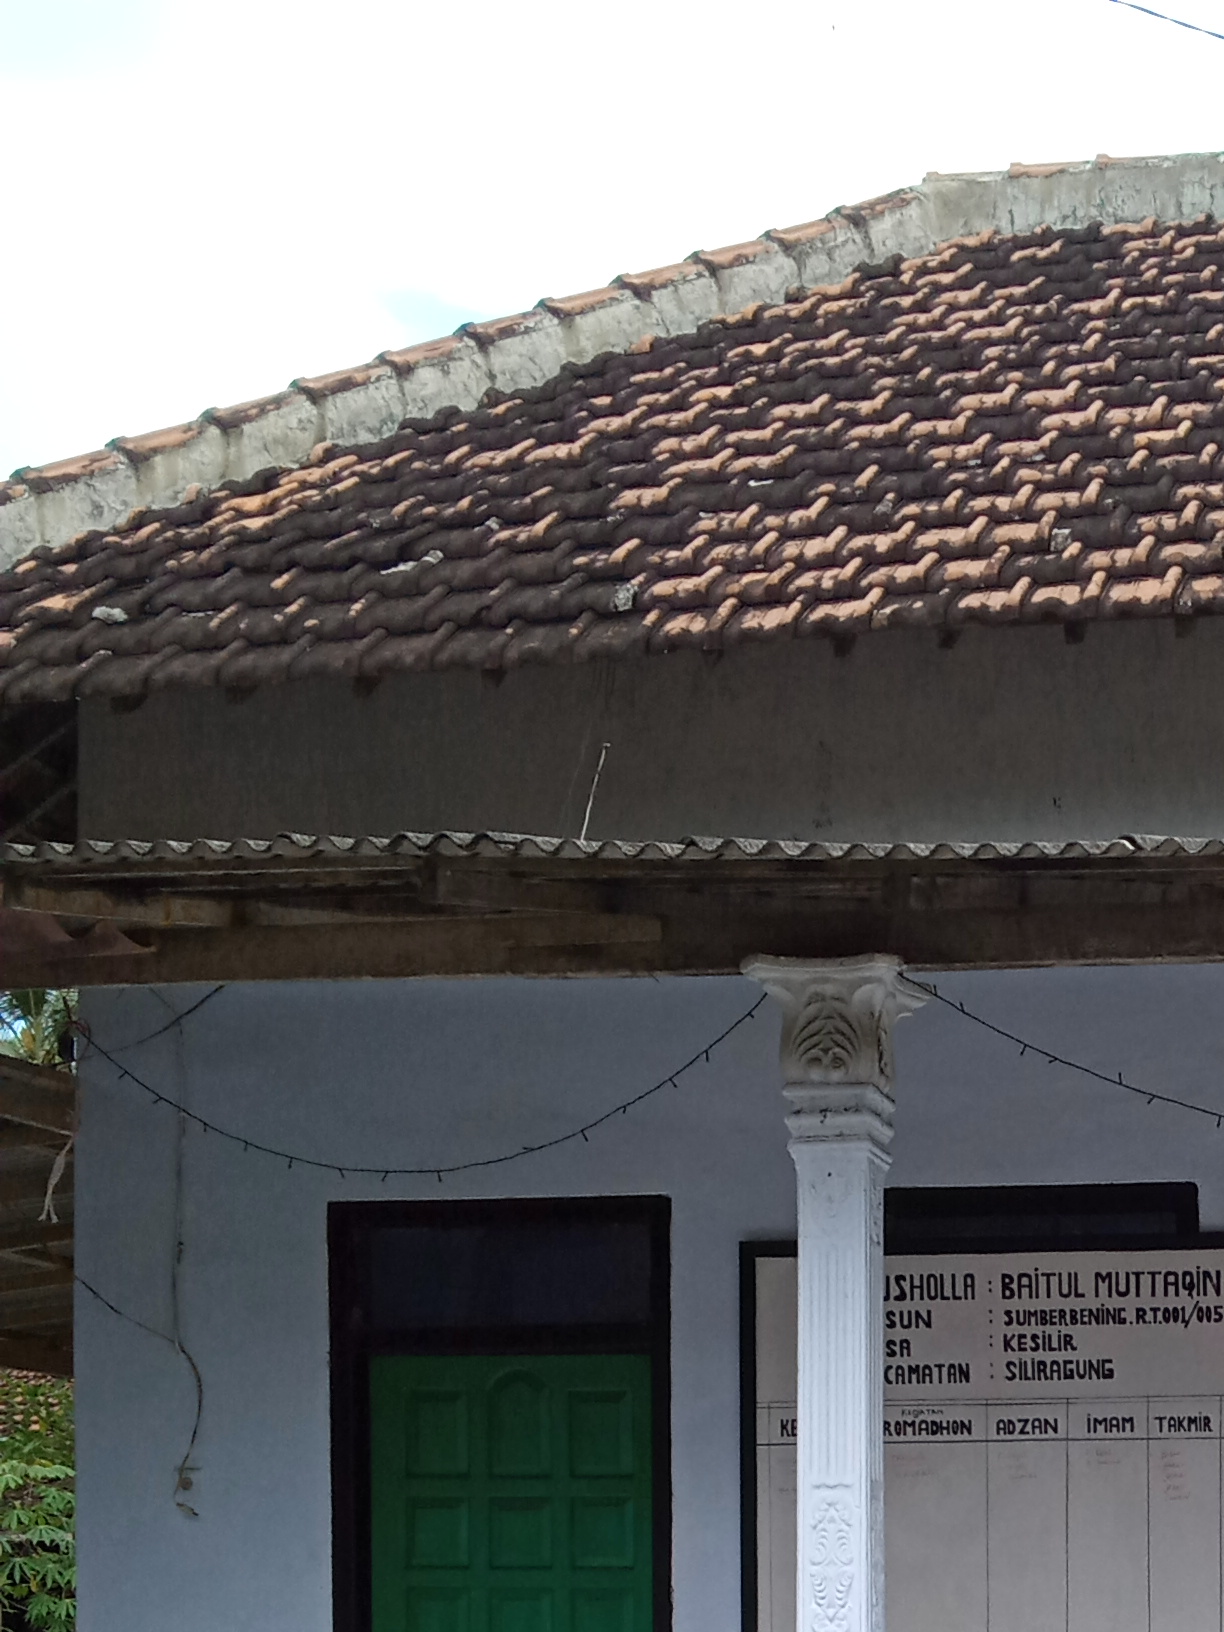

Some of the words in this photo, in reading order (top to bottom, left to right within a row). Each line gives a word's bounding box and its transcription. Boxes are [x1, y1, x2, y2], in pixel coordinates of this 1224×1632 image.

[885, 1309, 933, 1329] SUN
[885, 1338, 911, 1357] SA
[1003, 1330, 1078, 1352] KESILIR
[884, 1363, 970, 1385] CAMATAN
[1005, 1358, 1115, 1381] SILIRAGUNG
[883, 1419, 972, 1437] ROMADHON
[996, 1416, 1058, 1435] ADZAN
[1086, 1413, 1135, 1434] IMAM
[1155, 1411, 1213, 1433] TAKMIR
